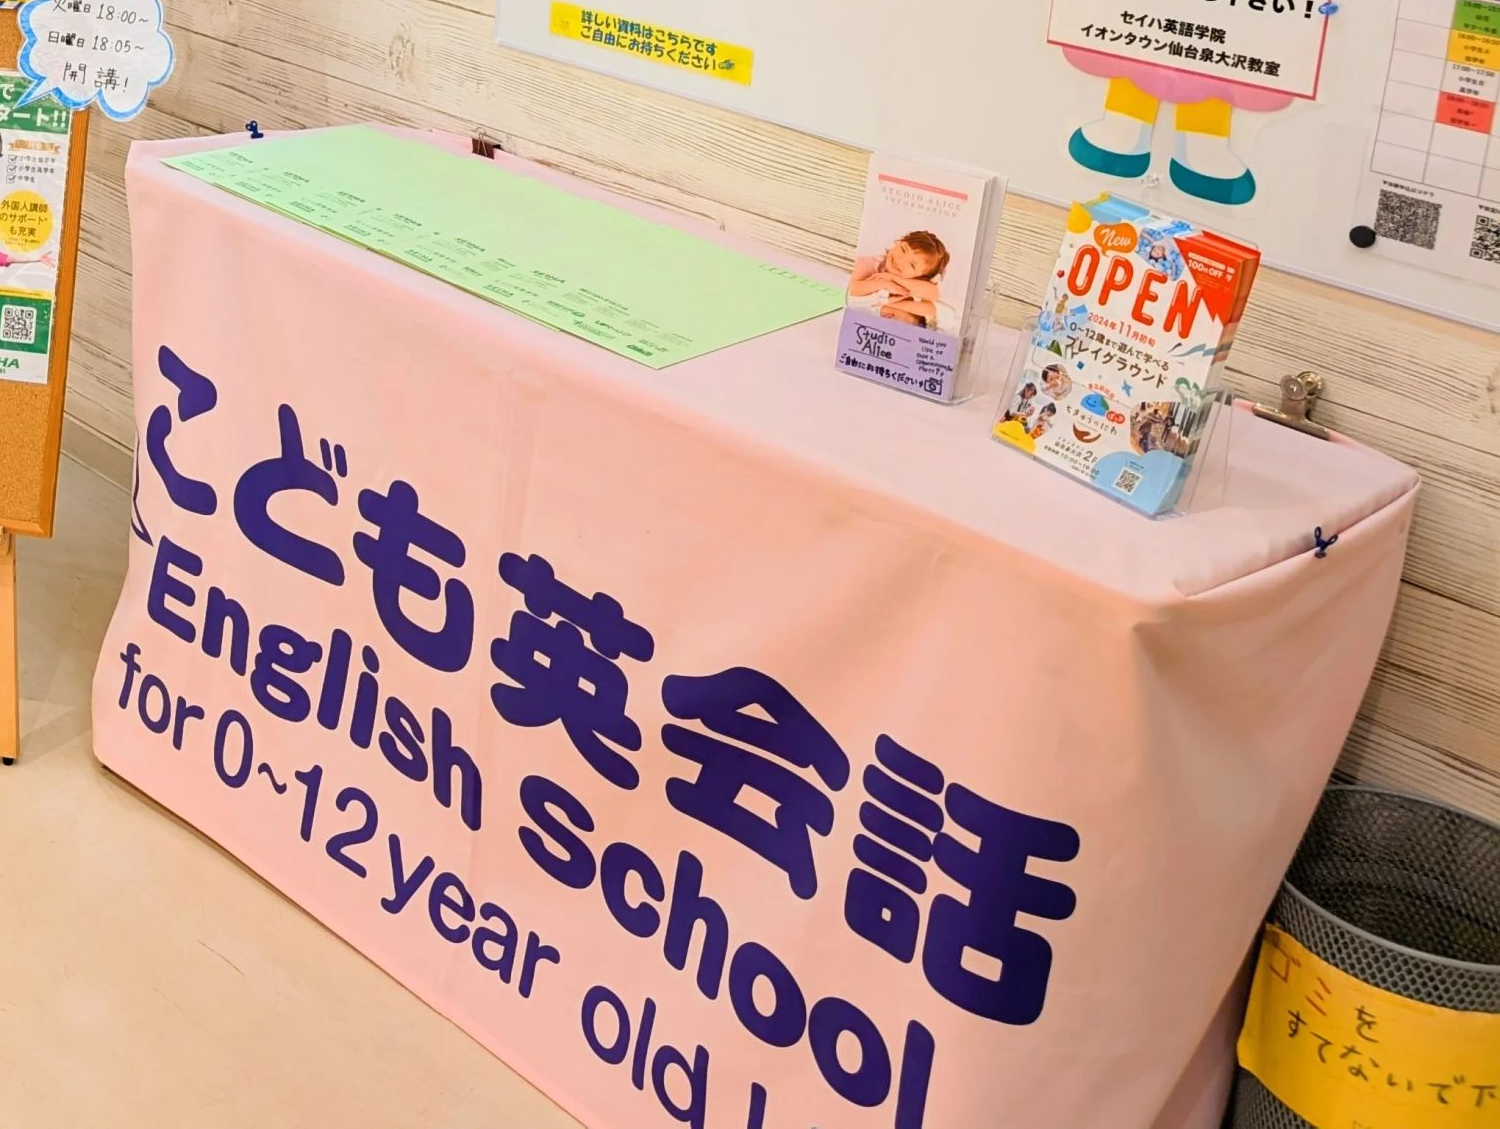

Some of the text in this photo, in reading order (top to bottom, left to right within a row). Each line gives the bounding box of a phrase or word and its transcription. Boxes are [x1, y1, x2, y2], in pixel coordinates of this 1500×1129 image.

[48, 31, 85, 48] 日曜日
[581, 9, 718, 56] 詳しい資料はこちらです
[1121, 10, 1226, 44] セイハ英語学院
[580, 26, 716, 71] ご自由にお持ちください
[1081, 24, 1280, 77] イオンタウン仙台泉大沢教室
[1, 200, 48, 213] 外国人講師
[882, 186, 962, 212] STUDIO ALICE
[885, 196, 958, 218] INFORMATION
[9, 226, 36, 237] も充実
[1100, 227, 1132, 248] New
[1067, 244, 1202, 339] OPEN
[856, 325, 896, 346] Studio
[1088, 312, 1156, 347] 2024年11月初旬
[861, 340, 892, 359] Alice
[839, 353, 918, 385] ご自由にお持ちください
[147, 344, 1079, 1027] こども英会話
[145, 536, 935, 1129] English School
[119, 643, 710, 1129] for 0~12 year old
